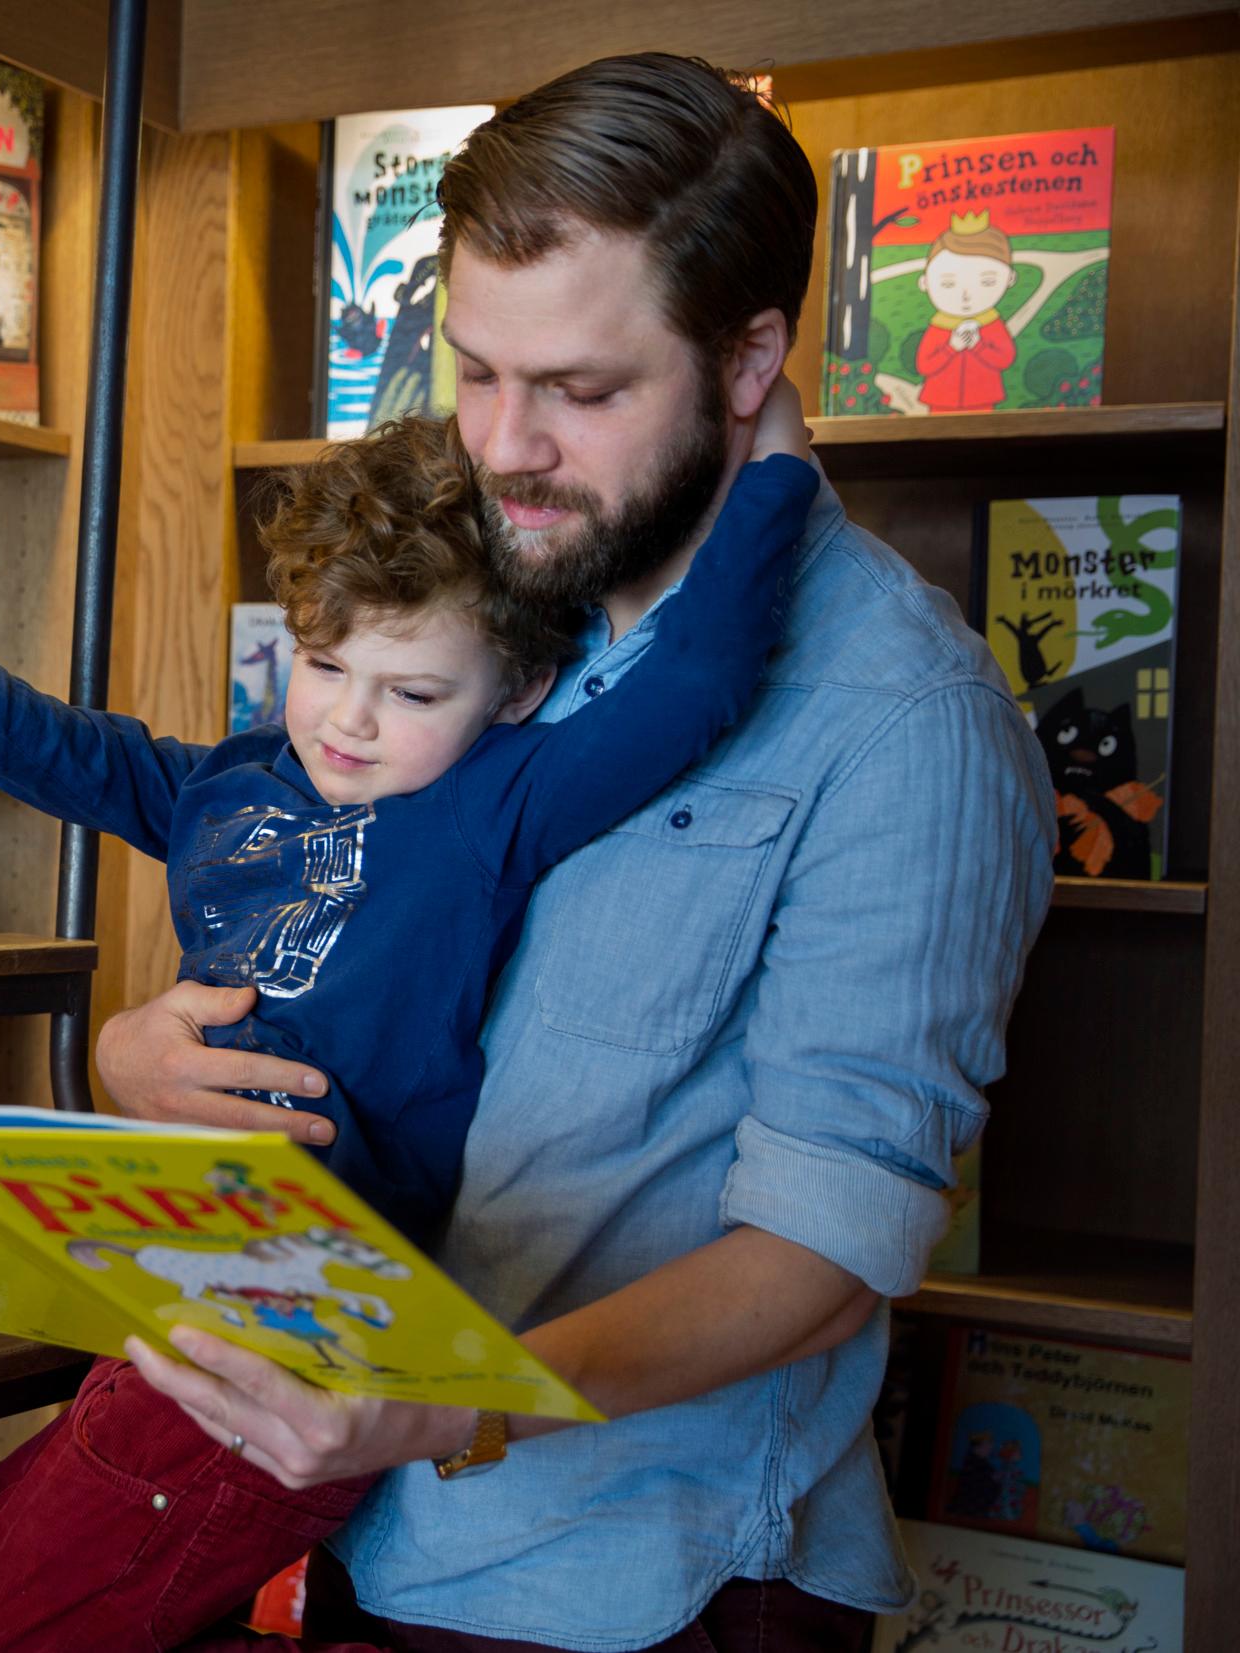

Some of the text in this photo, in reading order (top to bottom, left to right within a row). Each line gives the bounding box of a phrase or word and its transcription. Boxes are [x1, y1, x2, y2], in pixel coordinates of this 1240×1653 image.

[898, 143, 1105, 191] Prinsen och
[1010, 549, 1157, 580] Monster
[1037, 578, 1141, 602] mörkret
[963, 1575, 1107, 1626] Prinsessor
